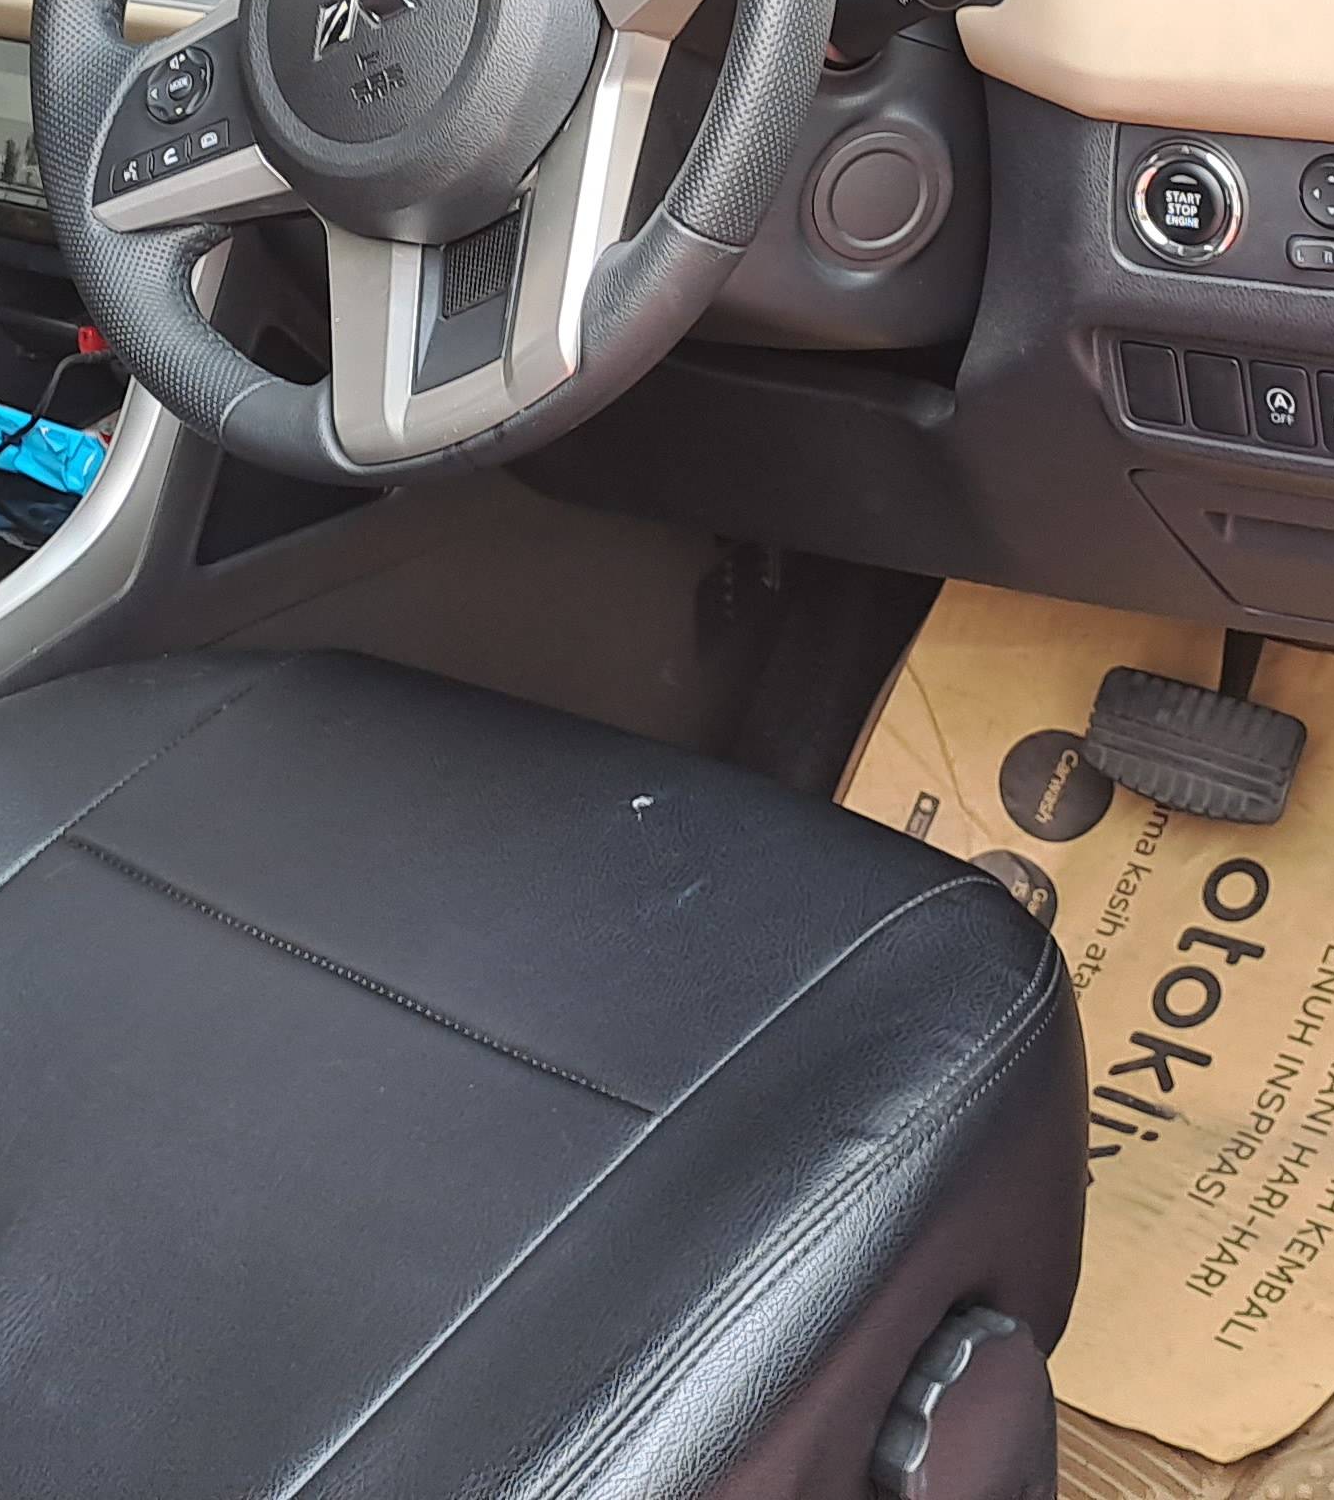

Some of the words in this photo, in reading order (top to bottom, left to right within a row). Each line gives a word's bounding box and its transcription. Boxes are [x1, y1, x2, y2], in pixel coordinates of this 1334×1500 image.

[1165, 189, 1202, 206] START
[1167, 202, 1199, 217] STOP
[1270, 411, 1295, 426] OFF
[1095, 861, 1153, 936] kasih
[1187, 1052, 1305, 1208] INSPIRASI
[1185, 1141, 1319, 1297] HARI-HARI
[1214, 1218, 1334, 1351] KEMBALI
